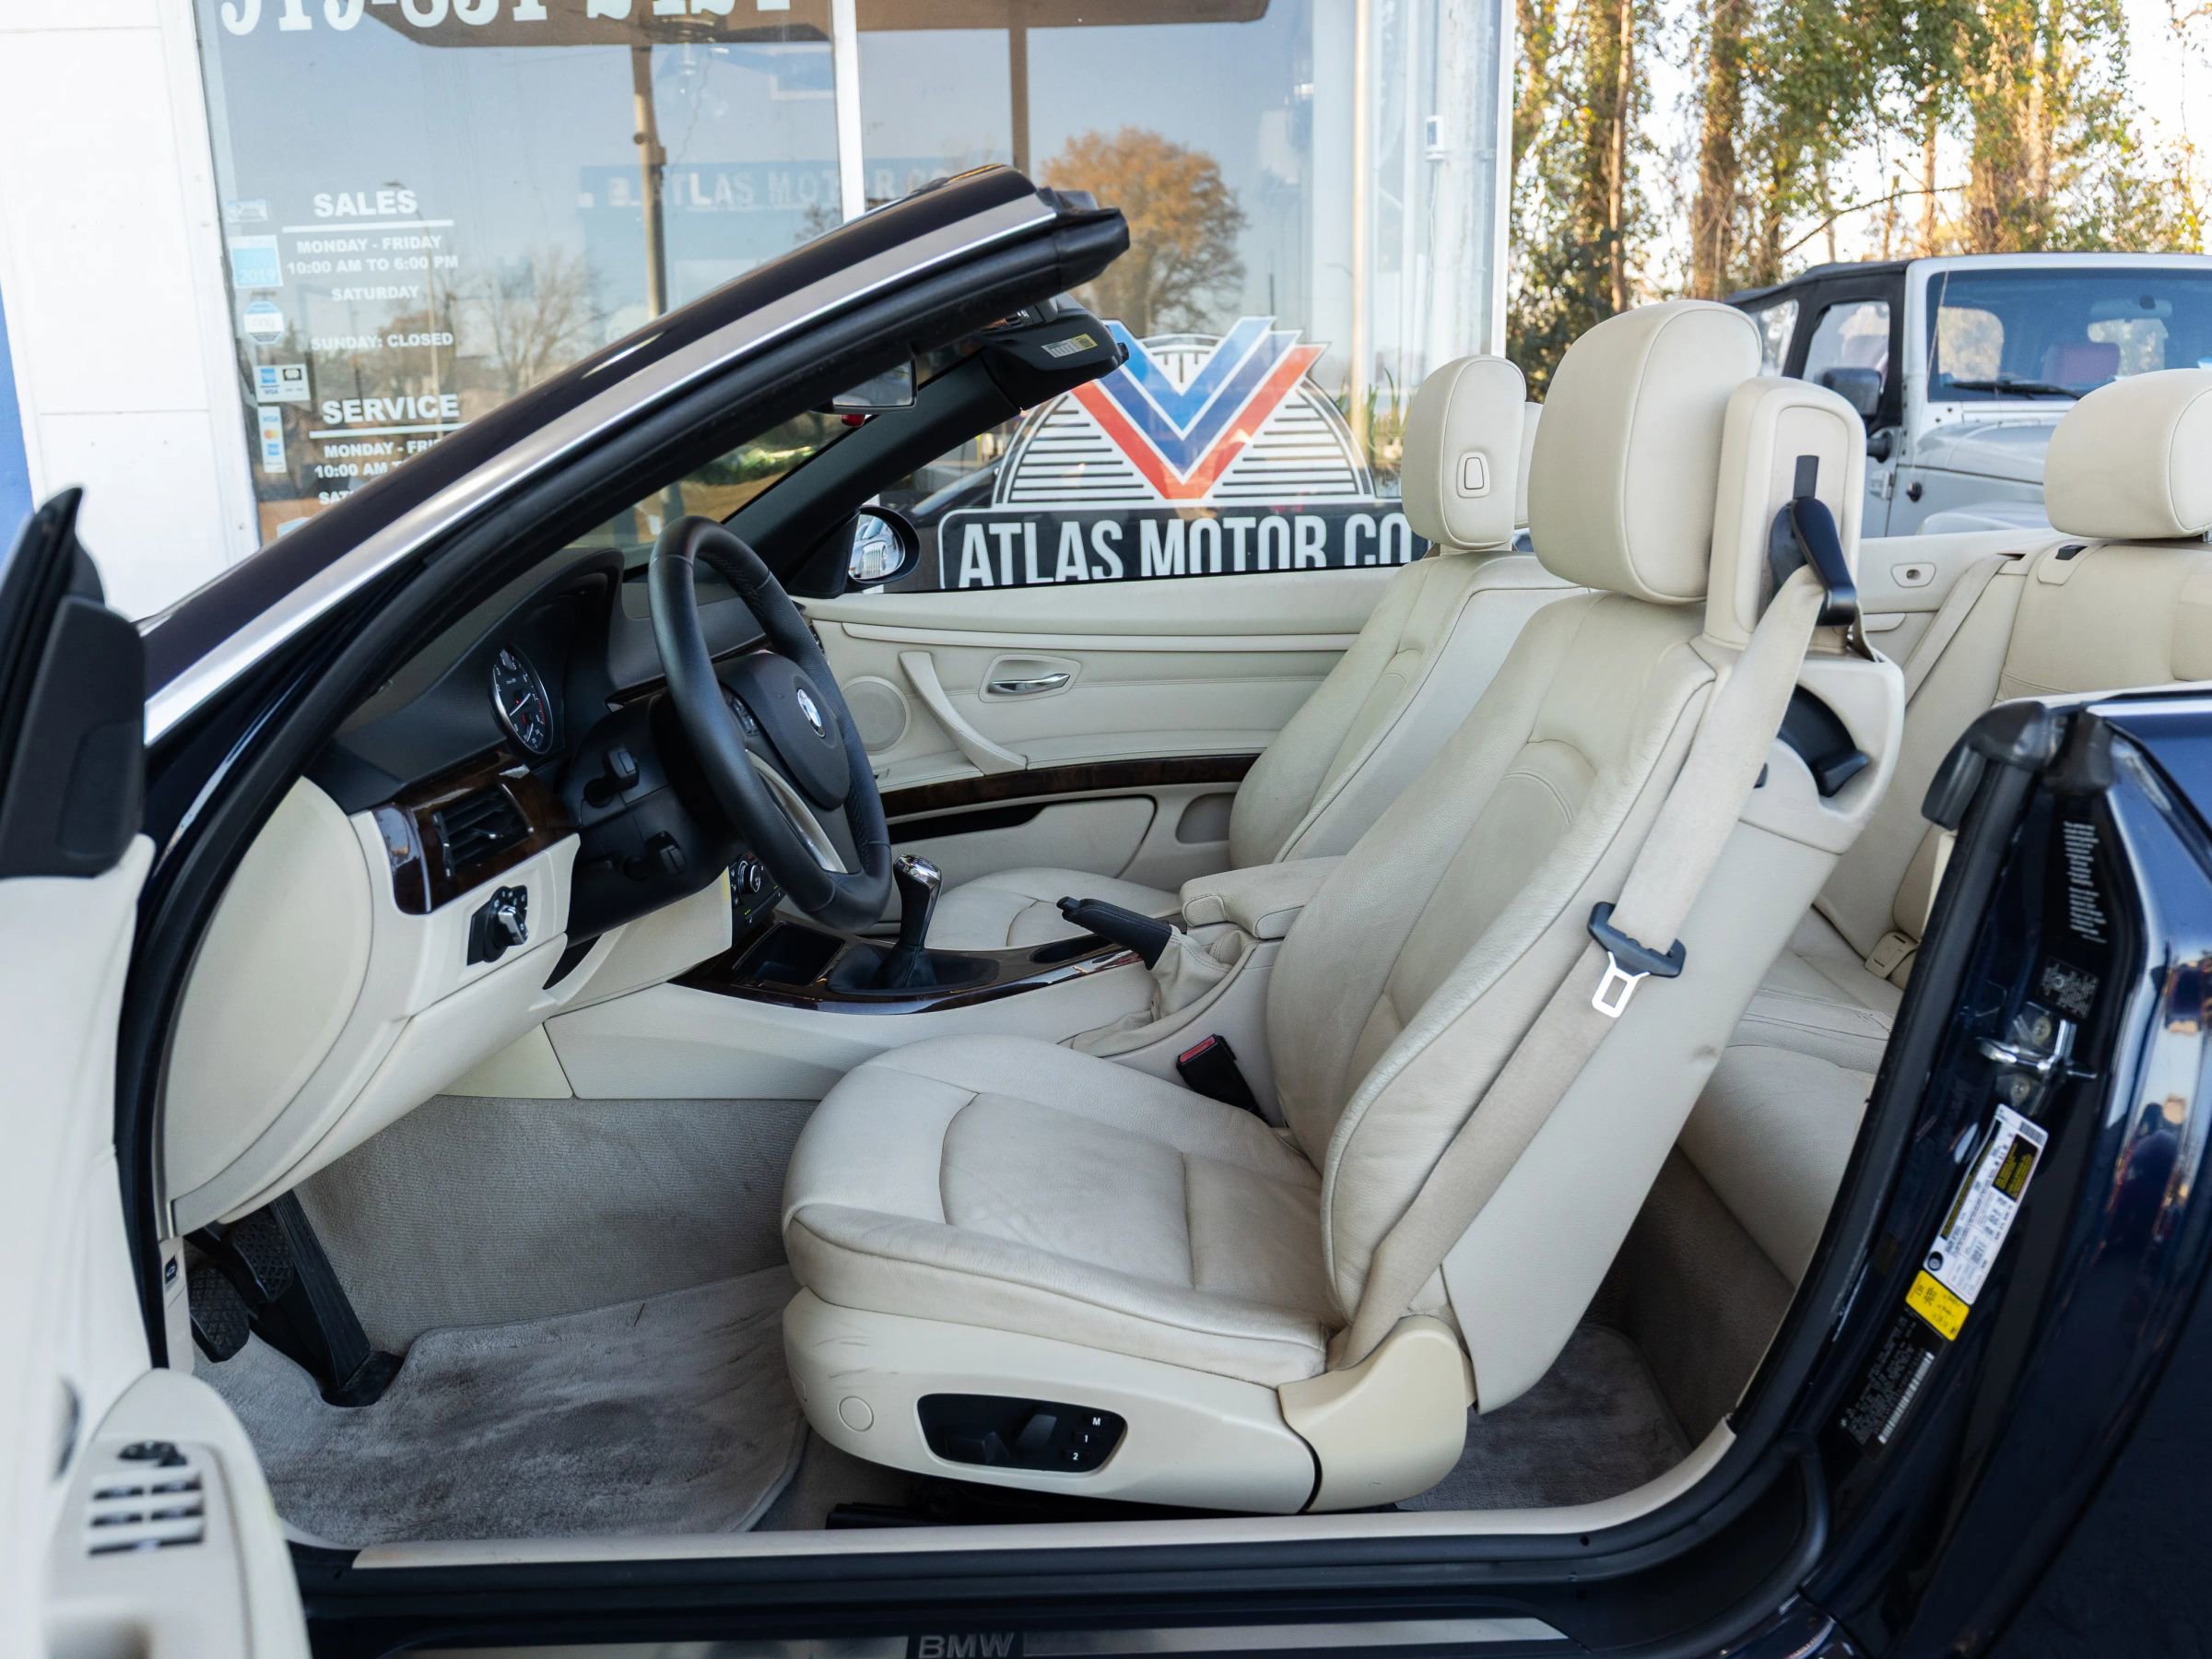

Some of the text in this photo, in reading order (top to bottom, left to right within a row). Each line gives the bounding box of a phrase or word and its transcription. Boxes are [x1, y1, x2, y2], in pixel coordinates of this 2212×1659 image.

[670, 171, 754, 207] TLAS
[313, 189, 418, 218] SALES
[296, 238, 368, 254] MONDAY
[382, 235, 442, 251] FRIDAY
[287, 254, 459, 275] 10:00 AM TO 6:00 PM
[331, 285, 420, 301] SATURDAY
[310, 332, 454, 351] SUNDAY: CLOSED
[322, 394, 460, 425] SERVICE
[324, 441, 394, 459] MONDAY
[314, 463, 359, 478] 10:00
[363, 461, 388, 476] AM
[318, 489, 355, 506] SAT
[959, 512, 1412, 587] ATLAS MOTOR CO
[1092, 1417, 1100, 1426] M
[918, 1632, 1015, 1659] BMW
